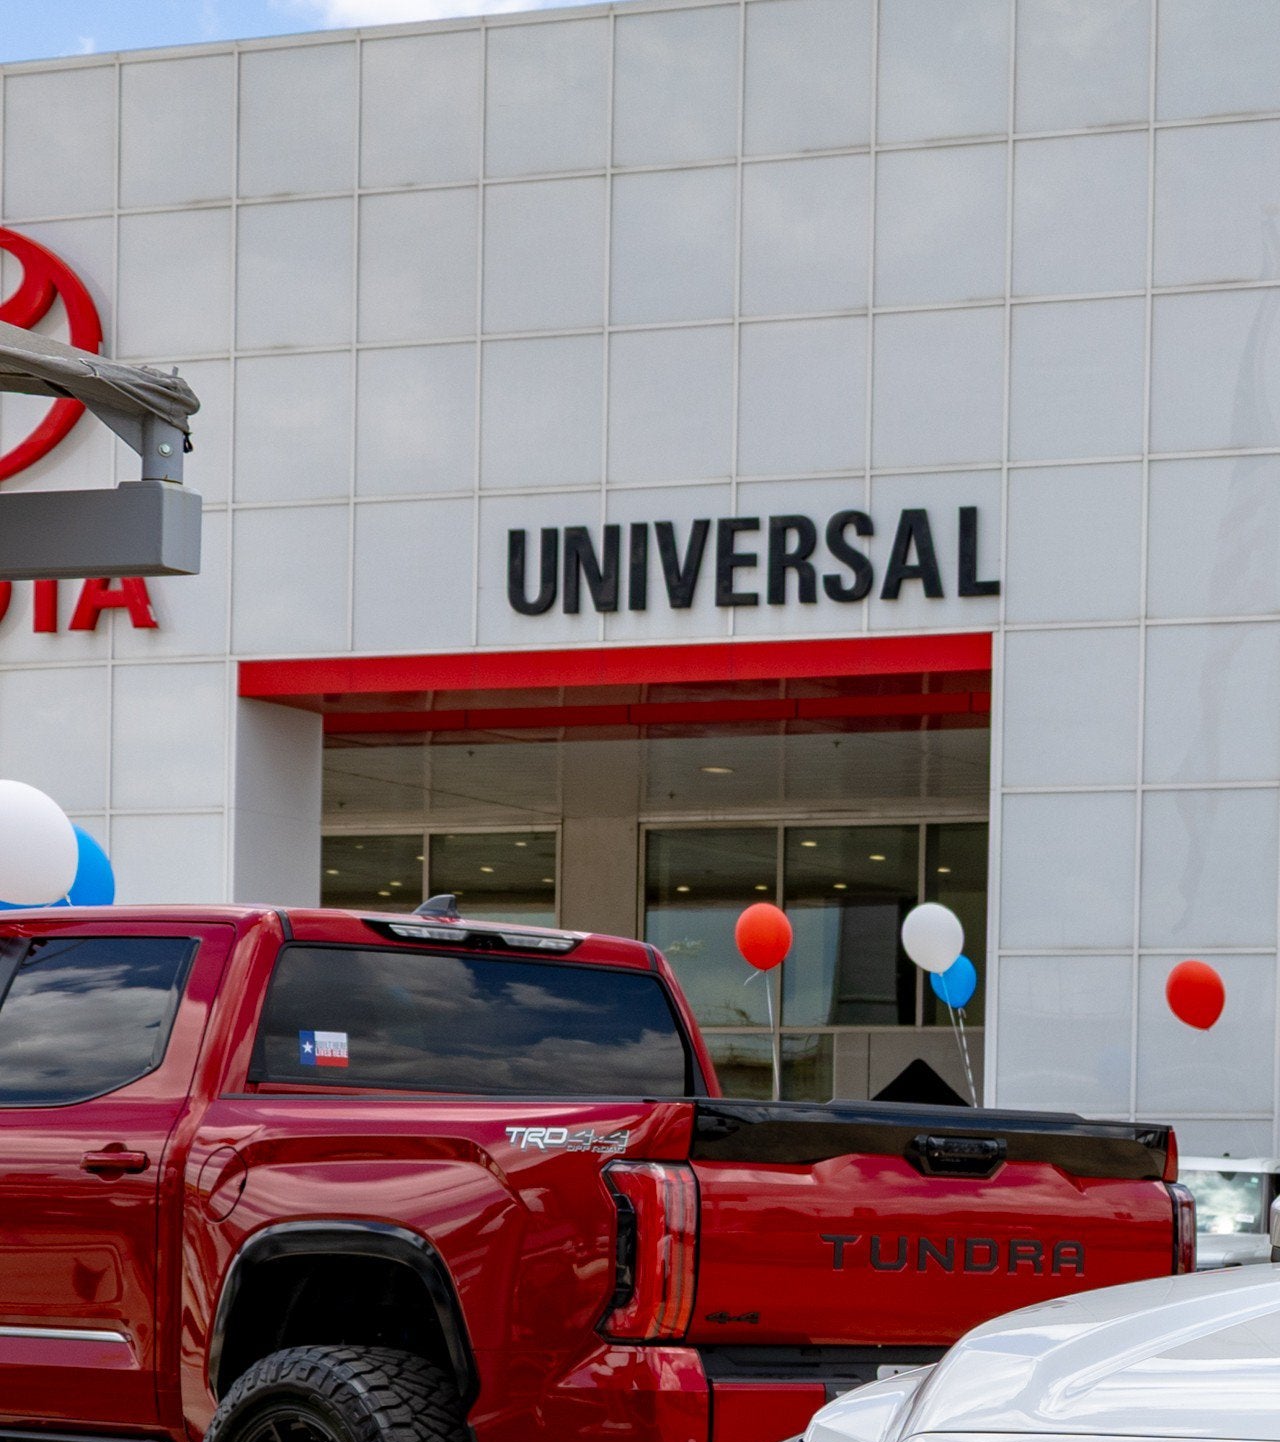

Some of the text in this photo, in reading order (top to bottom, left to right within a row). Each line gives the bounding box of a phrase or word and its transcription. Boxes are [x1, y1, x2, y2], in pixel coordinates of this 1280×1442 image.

[507, 506, 1001, 616] UNIVERSAL
[505, 1126, 568, 1150] TRD
[819, 1233, 1086, 1276] TUNDRA
